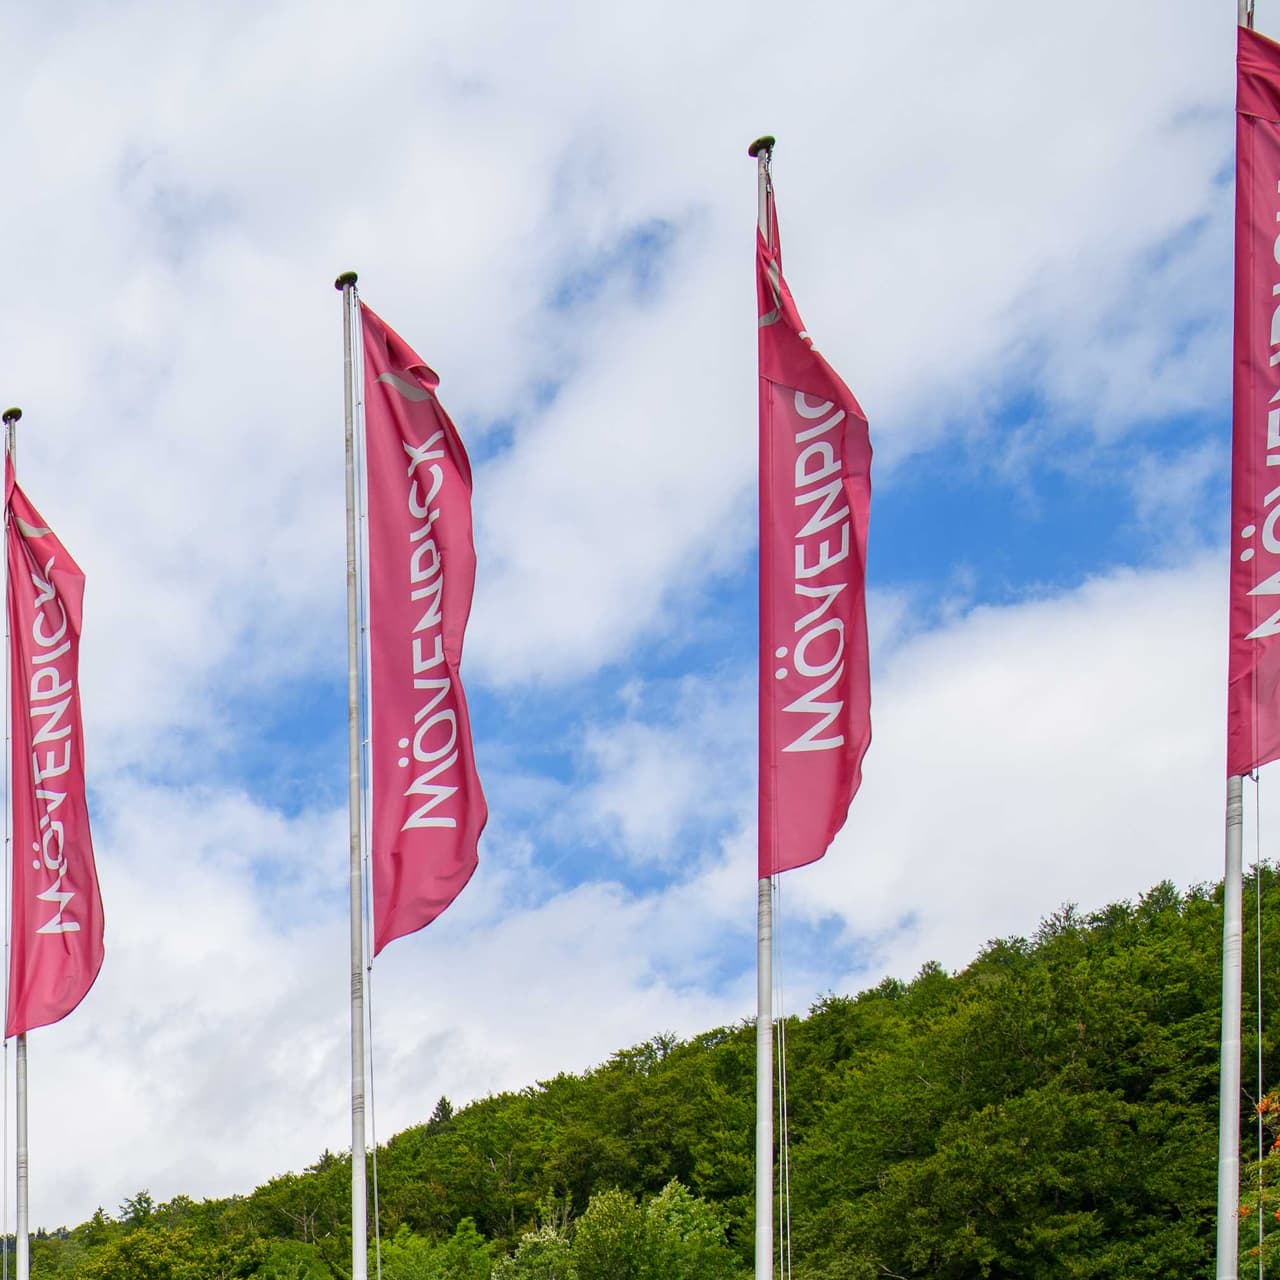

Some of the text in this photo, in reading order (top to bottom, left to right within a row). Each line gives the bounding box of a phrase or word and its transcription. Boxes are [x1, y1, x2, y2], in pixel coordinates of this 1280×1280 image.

[30, 555, 81, 934] MÖVENPICK
[396, 429, 458, 831] MÖVENPICK
[774, 390, 850, 752] MÖVENPIC
